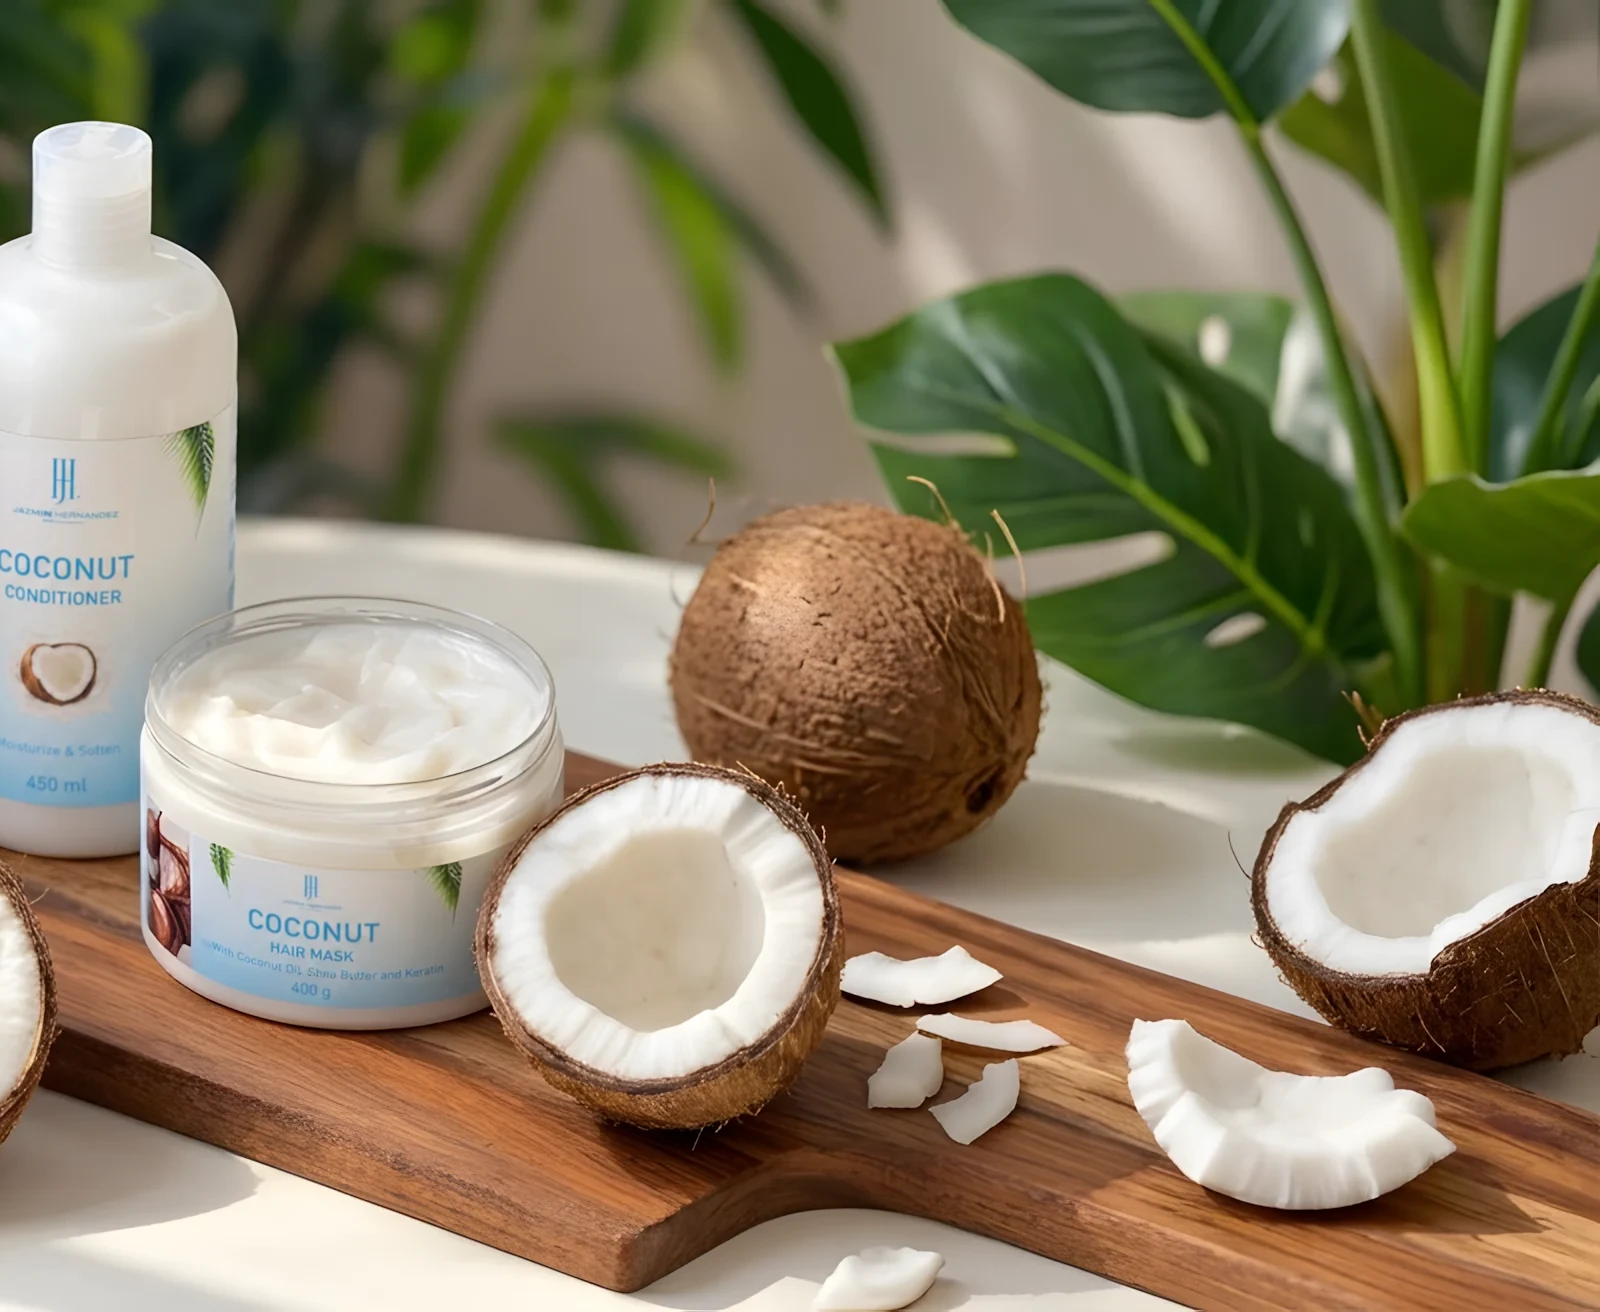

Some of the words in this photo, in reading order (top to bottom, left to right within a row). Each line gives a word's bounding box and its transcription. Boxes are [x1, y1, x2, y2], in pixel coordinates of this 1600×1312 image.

[13, 507, 52, 518] JAZMIN
[55, 511, 119, 519] HERNANDEZ
[5, 584, 122, 605] CONDITIONER
[65, 745, 74, 757] &
[78, 744, 121, 757] Soften
[26, 775, 58, 792] 450
[64, 777, 87, 792] ml
[248, 908, 380, 943] COCONUT
[212, 941, 234, 958] With
[237, 952, 282, 972] Coconut
[380, 970, 401, 979] and
[405, 964, 444, 978] Keratin
[270, 941, 305, 959] HAIR
[310, 948, 354, 962] MASK
[291, 982, 318, 996] 400
[322, 988, 331, 1000] g
